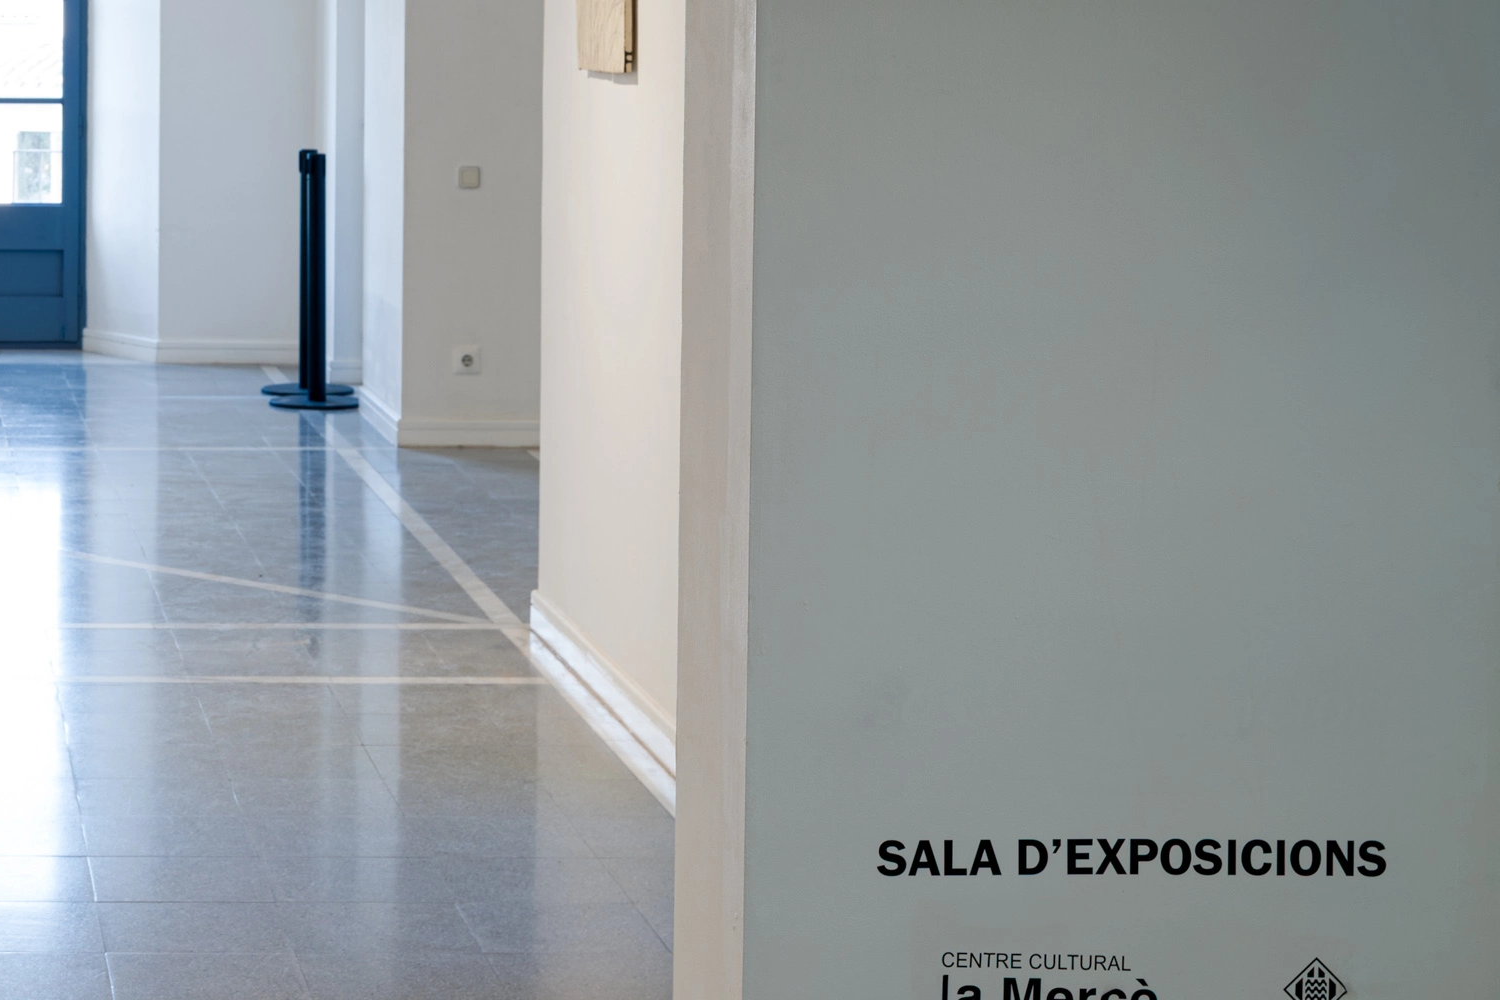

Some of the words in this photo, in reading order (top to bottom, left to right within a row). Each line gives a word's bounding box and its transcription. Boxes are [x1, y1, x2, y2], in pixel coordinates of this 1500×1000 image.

[877, 838, 1003, 878] SALA
[1018, 838, 1387, 878] D’EXPOSICIONS
[941, 951, 1022, 969] CENTRE
[1029, 953, 1132, 971] CULTURAL
